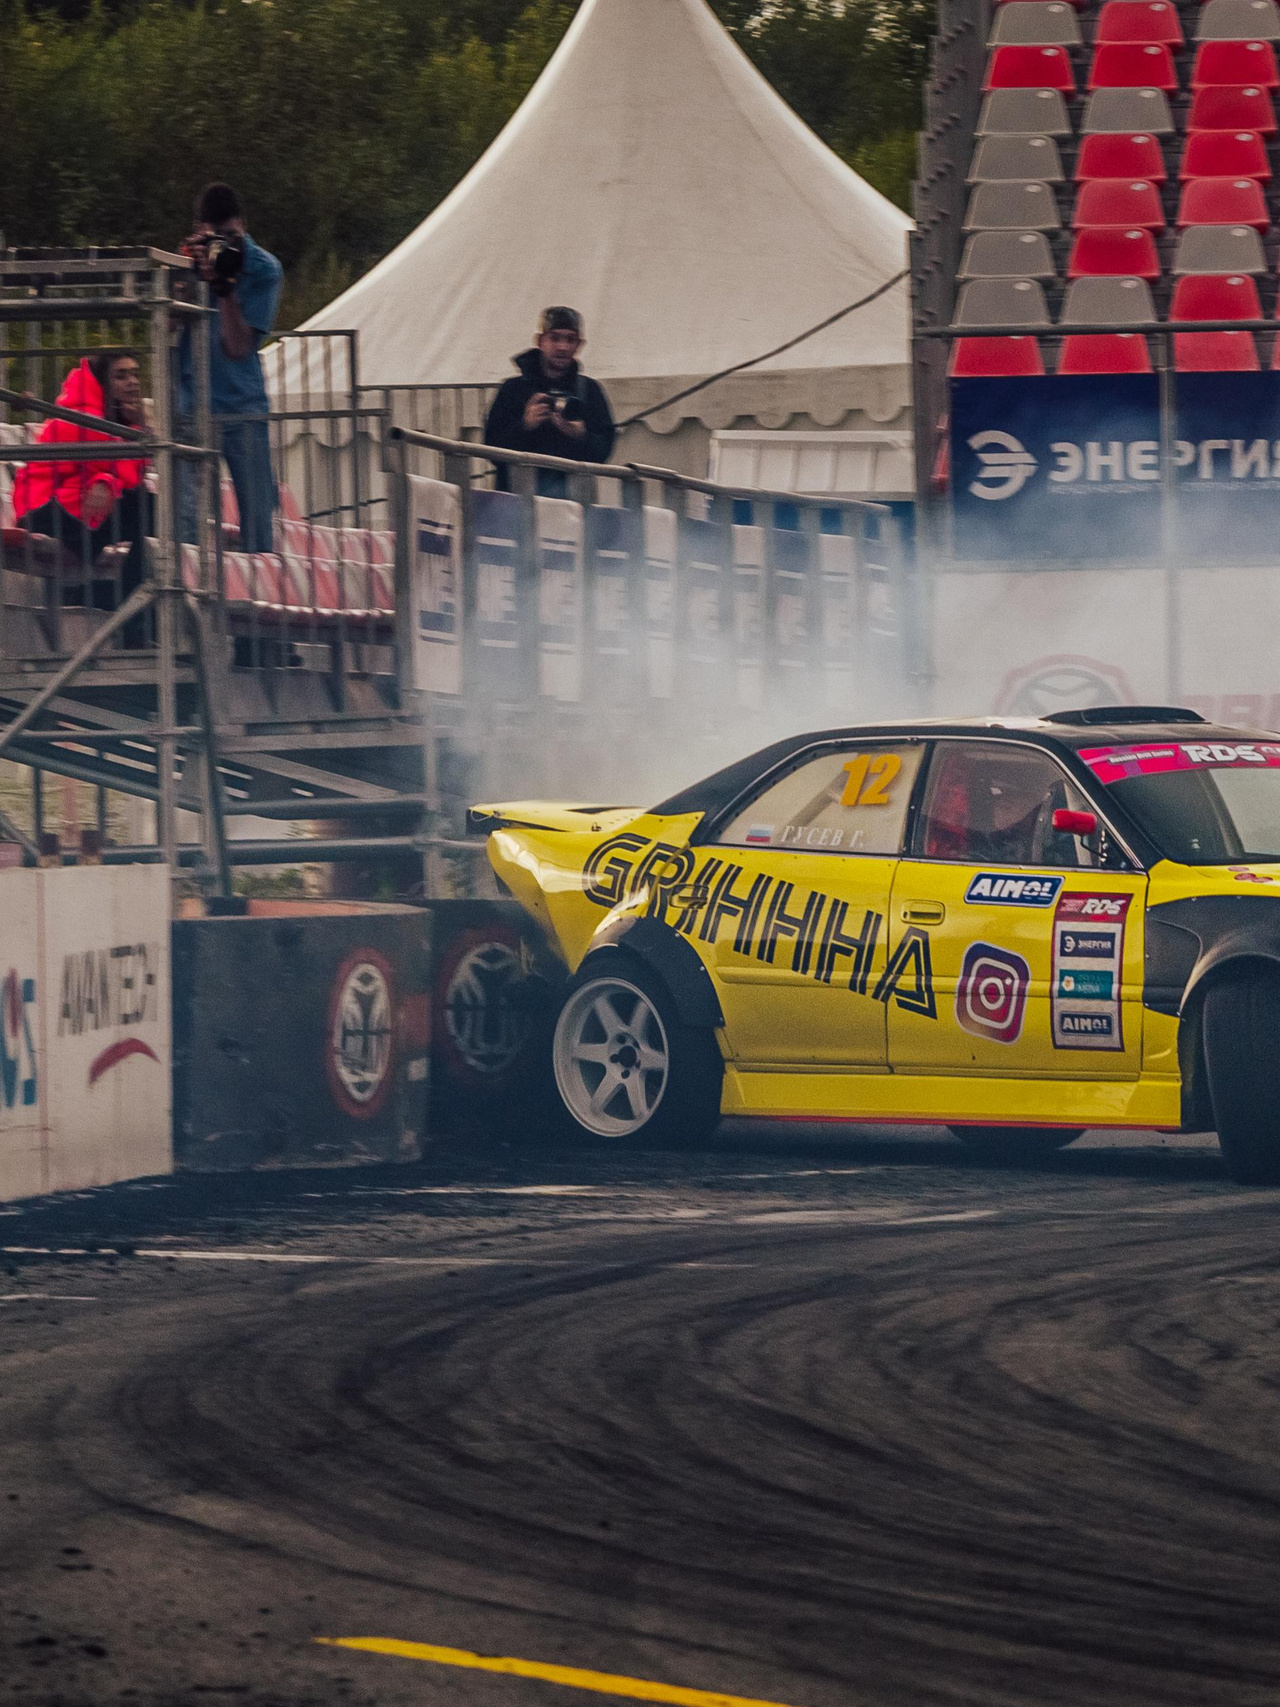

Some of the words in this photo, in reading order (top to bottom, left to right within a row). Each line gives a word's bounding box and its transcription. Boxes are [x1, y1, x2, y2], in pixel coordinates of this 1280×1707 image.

[1180, 745, 1266, 762] RDS
[839, 752, 902, 806] 12
[781, 825, 845, 847] ГУСЕВ
[970, 878, 1053, 898] AIMOL
[1081, 898, 1126, 914] RDS
[1062, 1016, 1108, 1031] AIMOL
